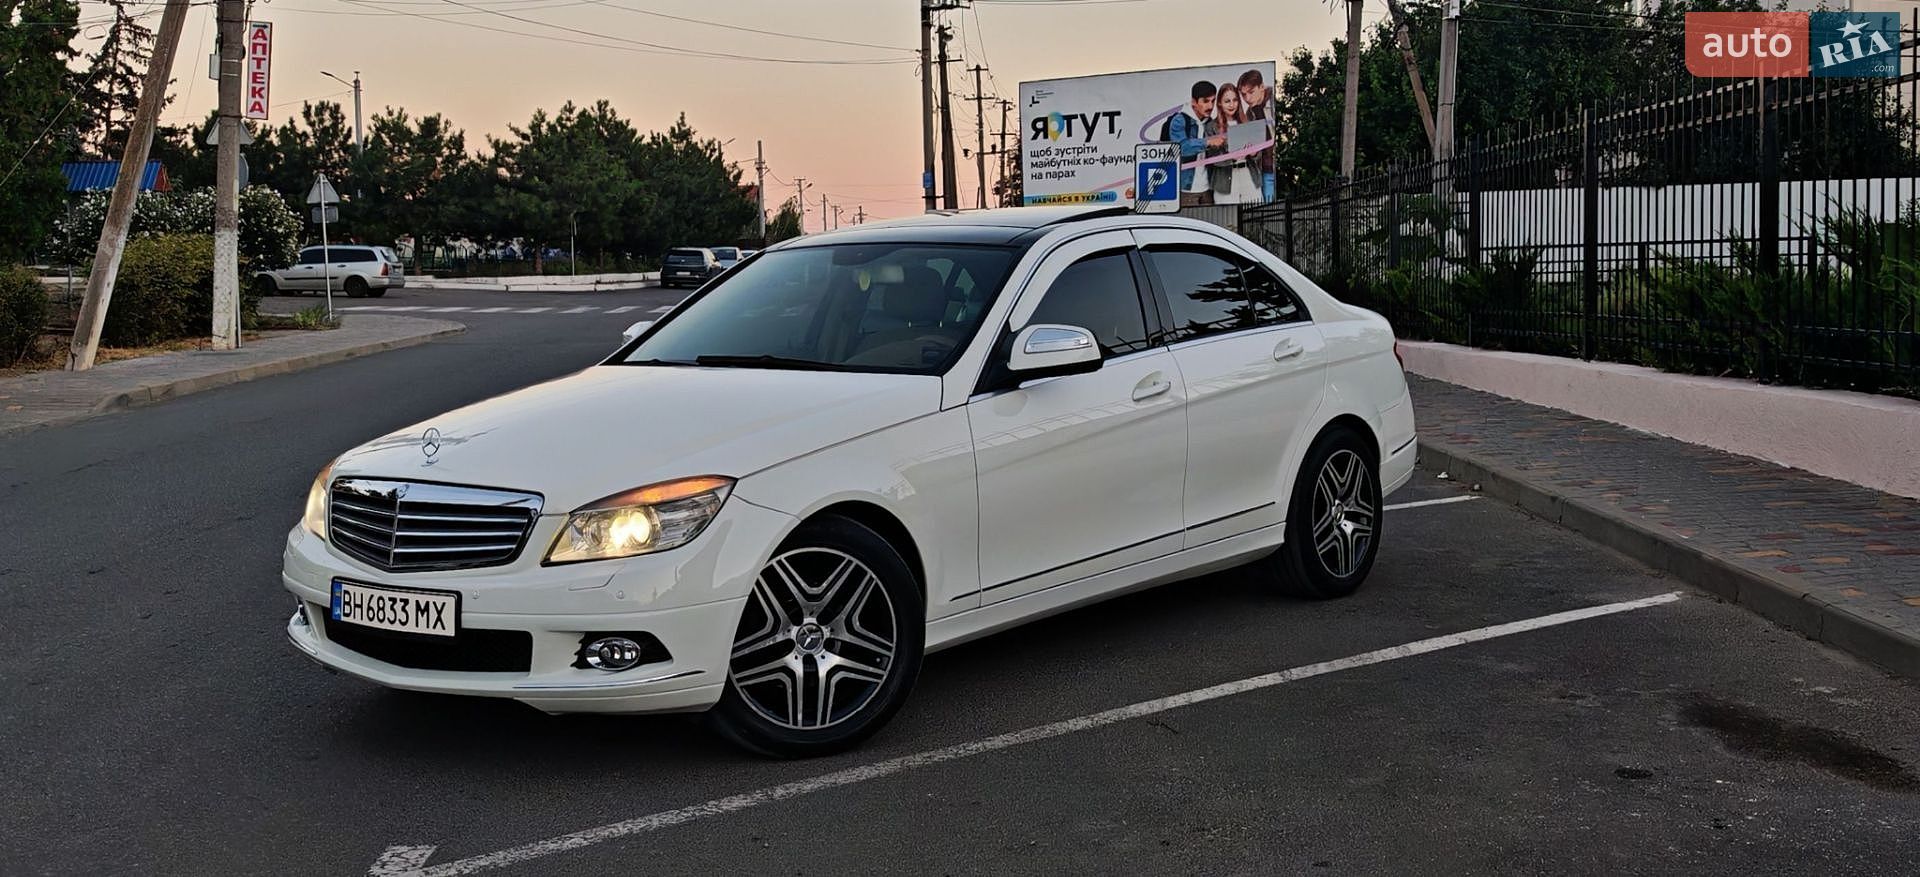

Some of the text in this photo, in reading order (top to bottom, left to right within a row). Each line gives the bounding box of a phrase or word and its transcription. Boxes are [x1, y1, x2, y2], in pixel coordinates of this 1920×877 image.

[249, 28, 267, 113] АПТЕКА
[1030, 143, 1098, 158] щоб зустріти
[1030, 155, 1081, 169] майбутніх
[1031, 169, 1076, 181] на парах
